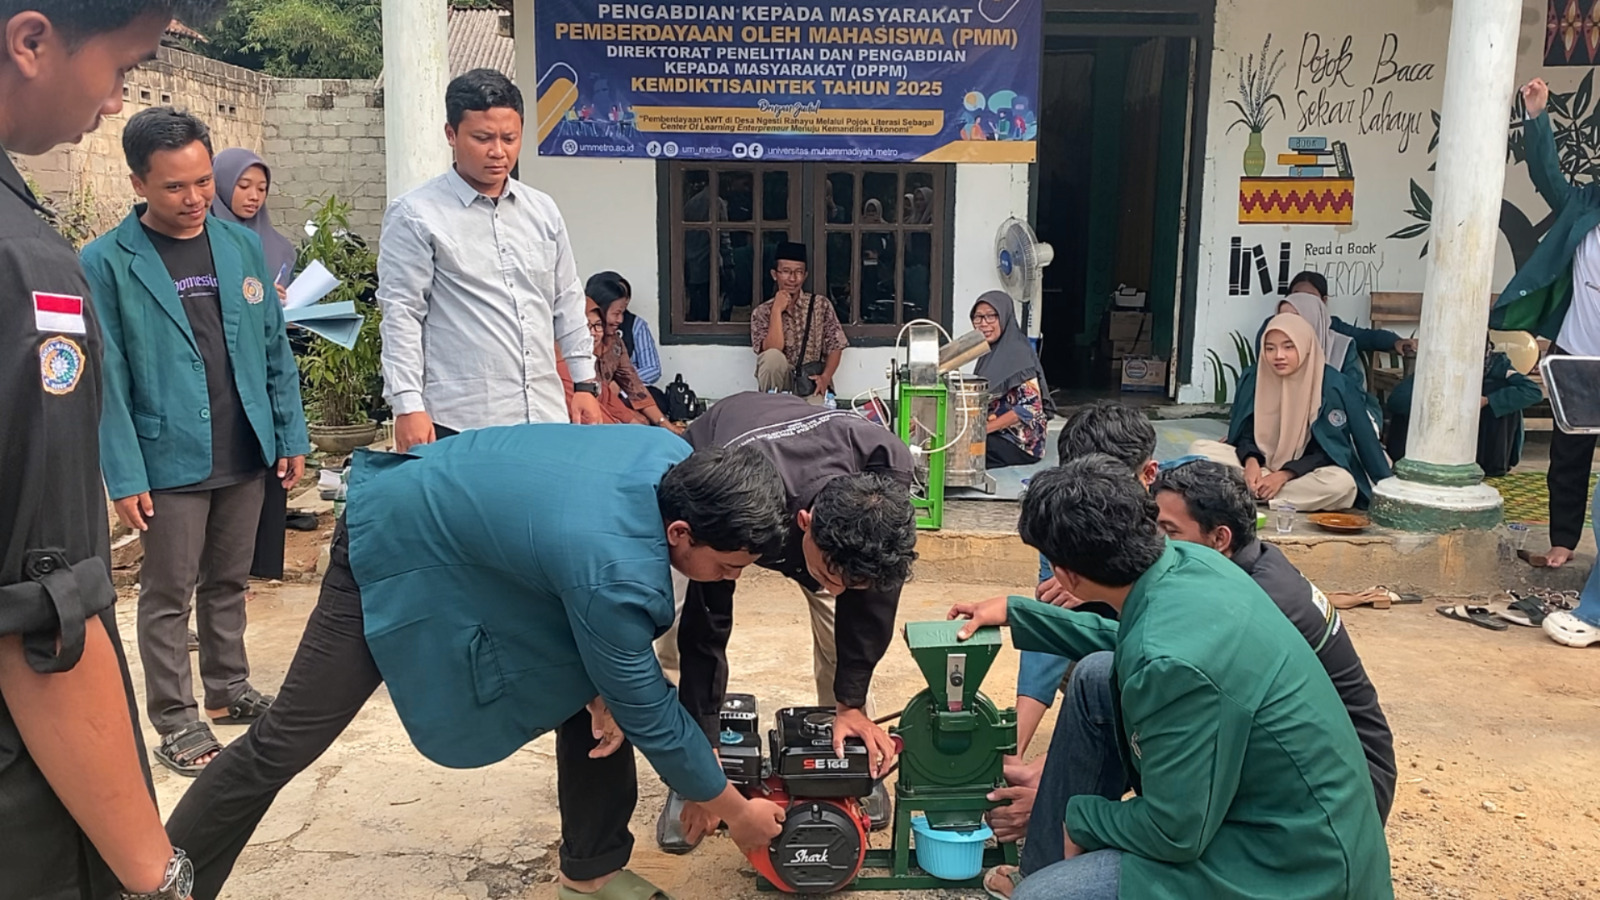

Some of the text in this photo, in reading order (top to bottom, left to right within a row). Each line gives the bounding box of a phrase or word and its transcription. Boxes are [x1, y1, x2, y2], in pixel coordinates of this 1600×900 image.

[598, 4, 973, 24] PENGABDIAN KEPADA MASYARAKAT
[555, 23, 1018, 50] PEMBERDAYAAN OLEH MAHASISWA (PMM)
[607, 45, 966, 62] DIREKTORAT PENELITIAN DAN PENGABDIAN
[1294, 31, 1435, 90] Pojok Baca
[665, 62, 908, 80] KEPADA MASYARAKAT (DPPM)
[631, 77, 943, 96] KEMDIKTISAINTEK TAHUN 2025
[700, 124, 735, 132] Learning
[725, 116, 733, 124] di
[734, 116, 754, 124] Desa
[756, 117, 782, 126] Ngesti
[846, 118, 868, 127] Pojok
[871, 118, 900, 126] Literasi
[902, 119, 934, 127] Sebagai
[1297, 87, 1422, 153] Sekar Rahayu
[579, 144, 635, 153] ummetro.ac.id
[681, 146, 722, 155] um_metro
[767, 147, 898, 157] universitas muhammadiyah metro
[1305, 241, 1377, 256] Read a Book
[1304, 258, 1384, 297] ERYDAY
[790, 848, 828, 863] Shark
